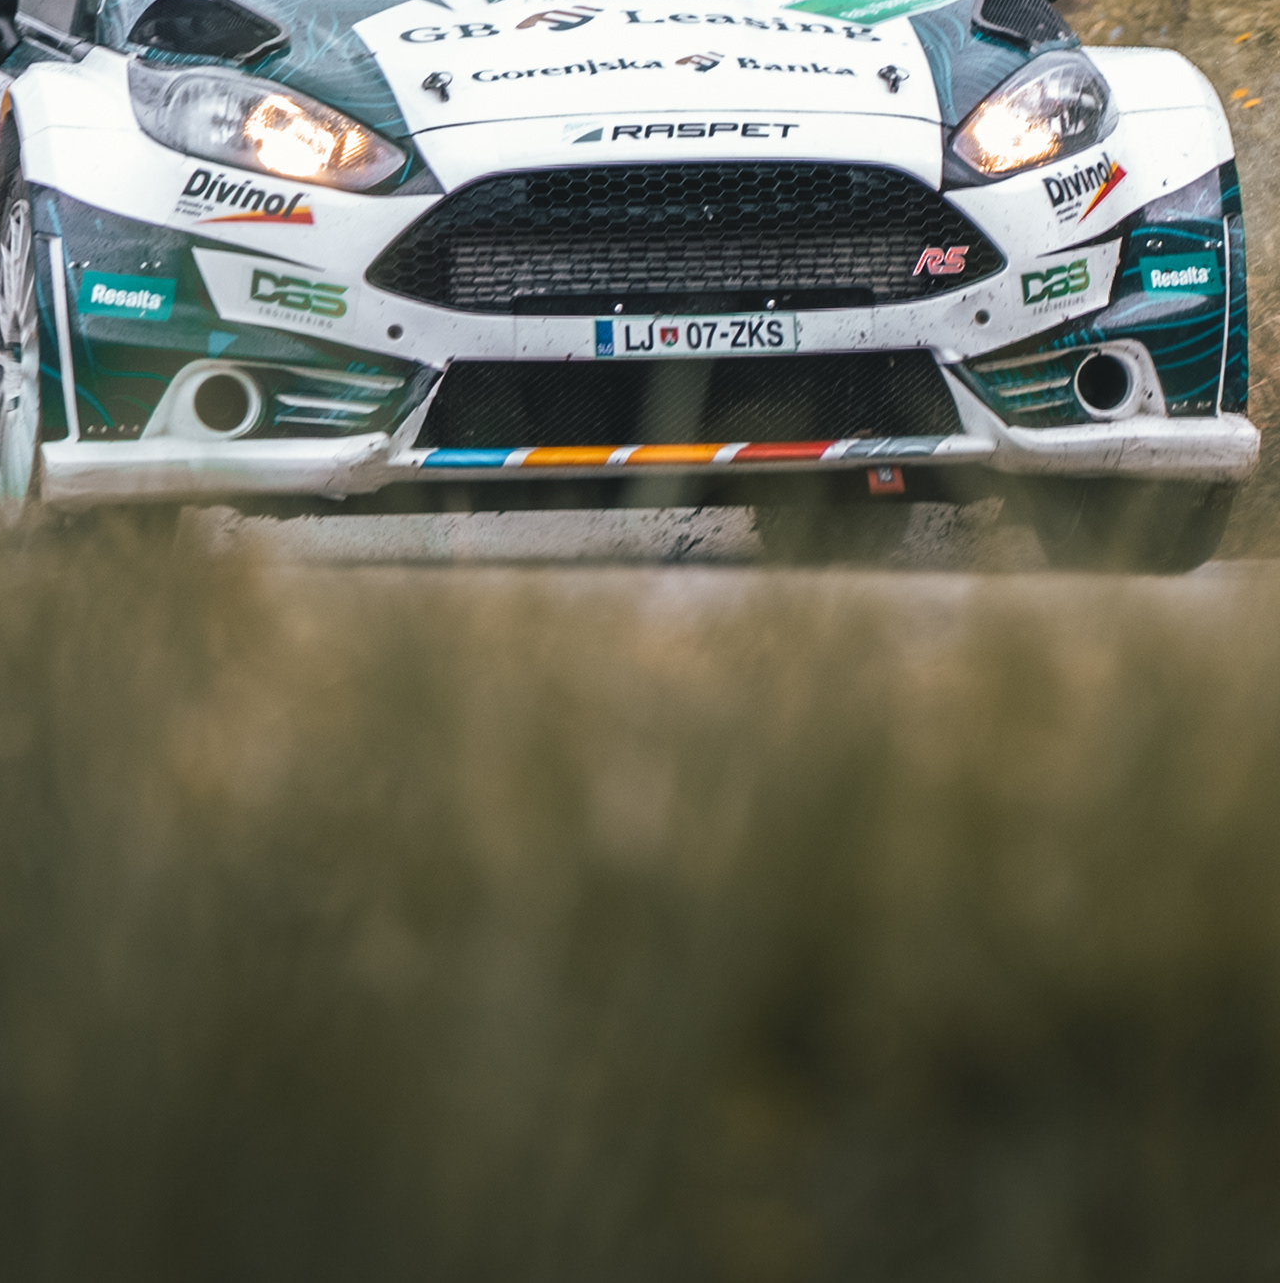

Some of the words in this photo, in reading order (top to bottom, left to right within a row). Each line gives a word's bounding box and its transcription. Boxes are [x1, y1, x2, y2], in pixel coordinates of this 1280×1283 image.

[399, 23, 501, 43] GB
[620, 8, 881, 43] Leasing
[472, 57, 665, 83] Gorenjska
[736, 56, 858, 77] Banka
[611, 122, 800, 141] RASPET
[181, 167, 306, 220] Divinol
[1042, 152, 1117, 208] Divinol
[912, 245, 970, 276] RS
[250, 268, 349, 319] DBS
[1021, 258, 1091, 305] DBS
[1150, 266, 1210, 289] Resalta
[90, 282, 164, 311] Resalta
[624, 323, 655, 352] LJ
[685, 319, 785, 350] 07-ZKS
